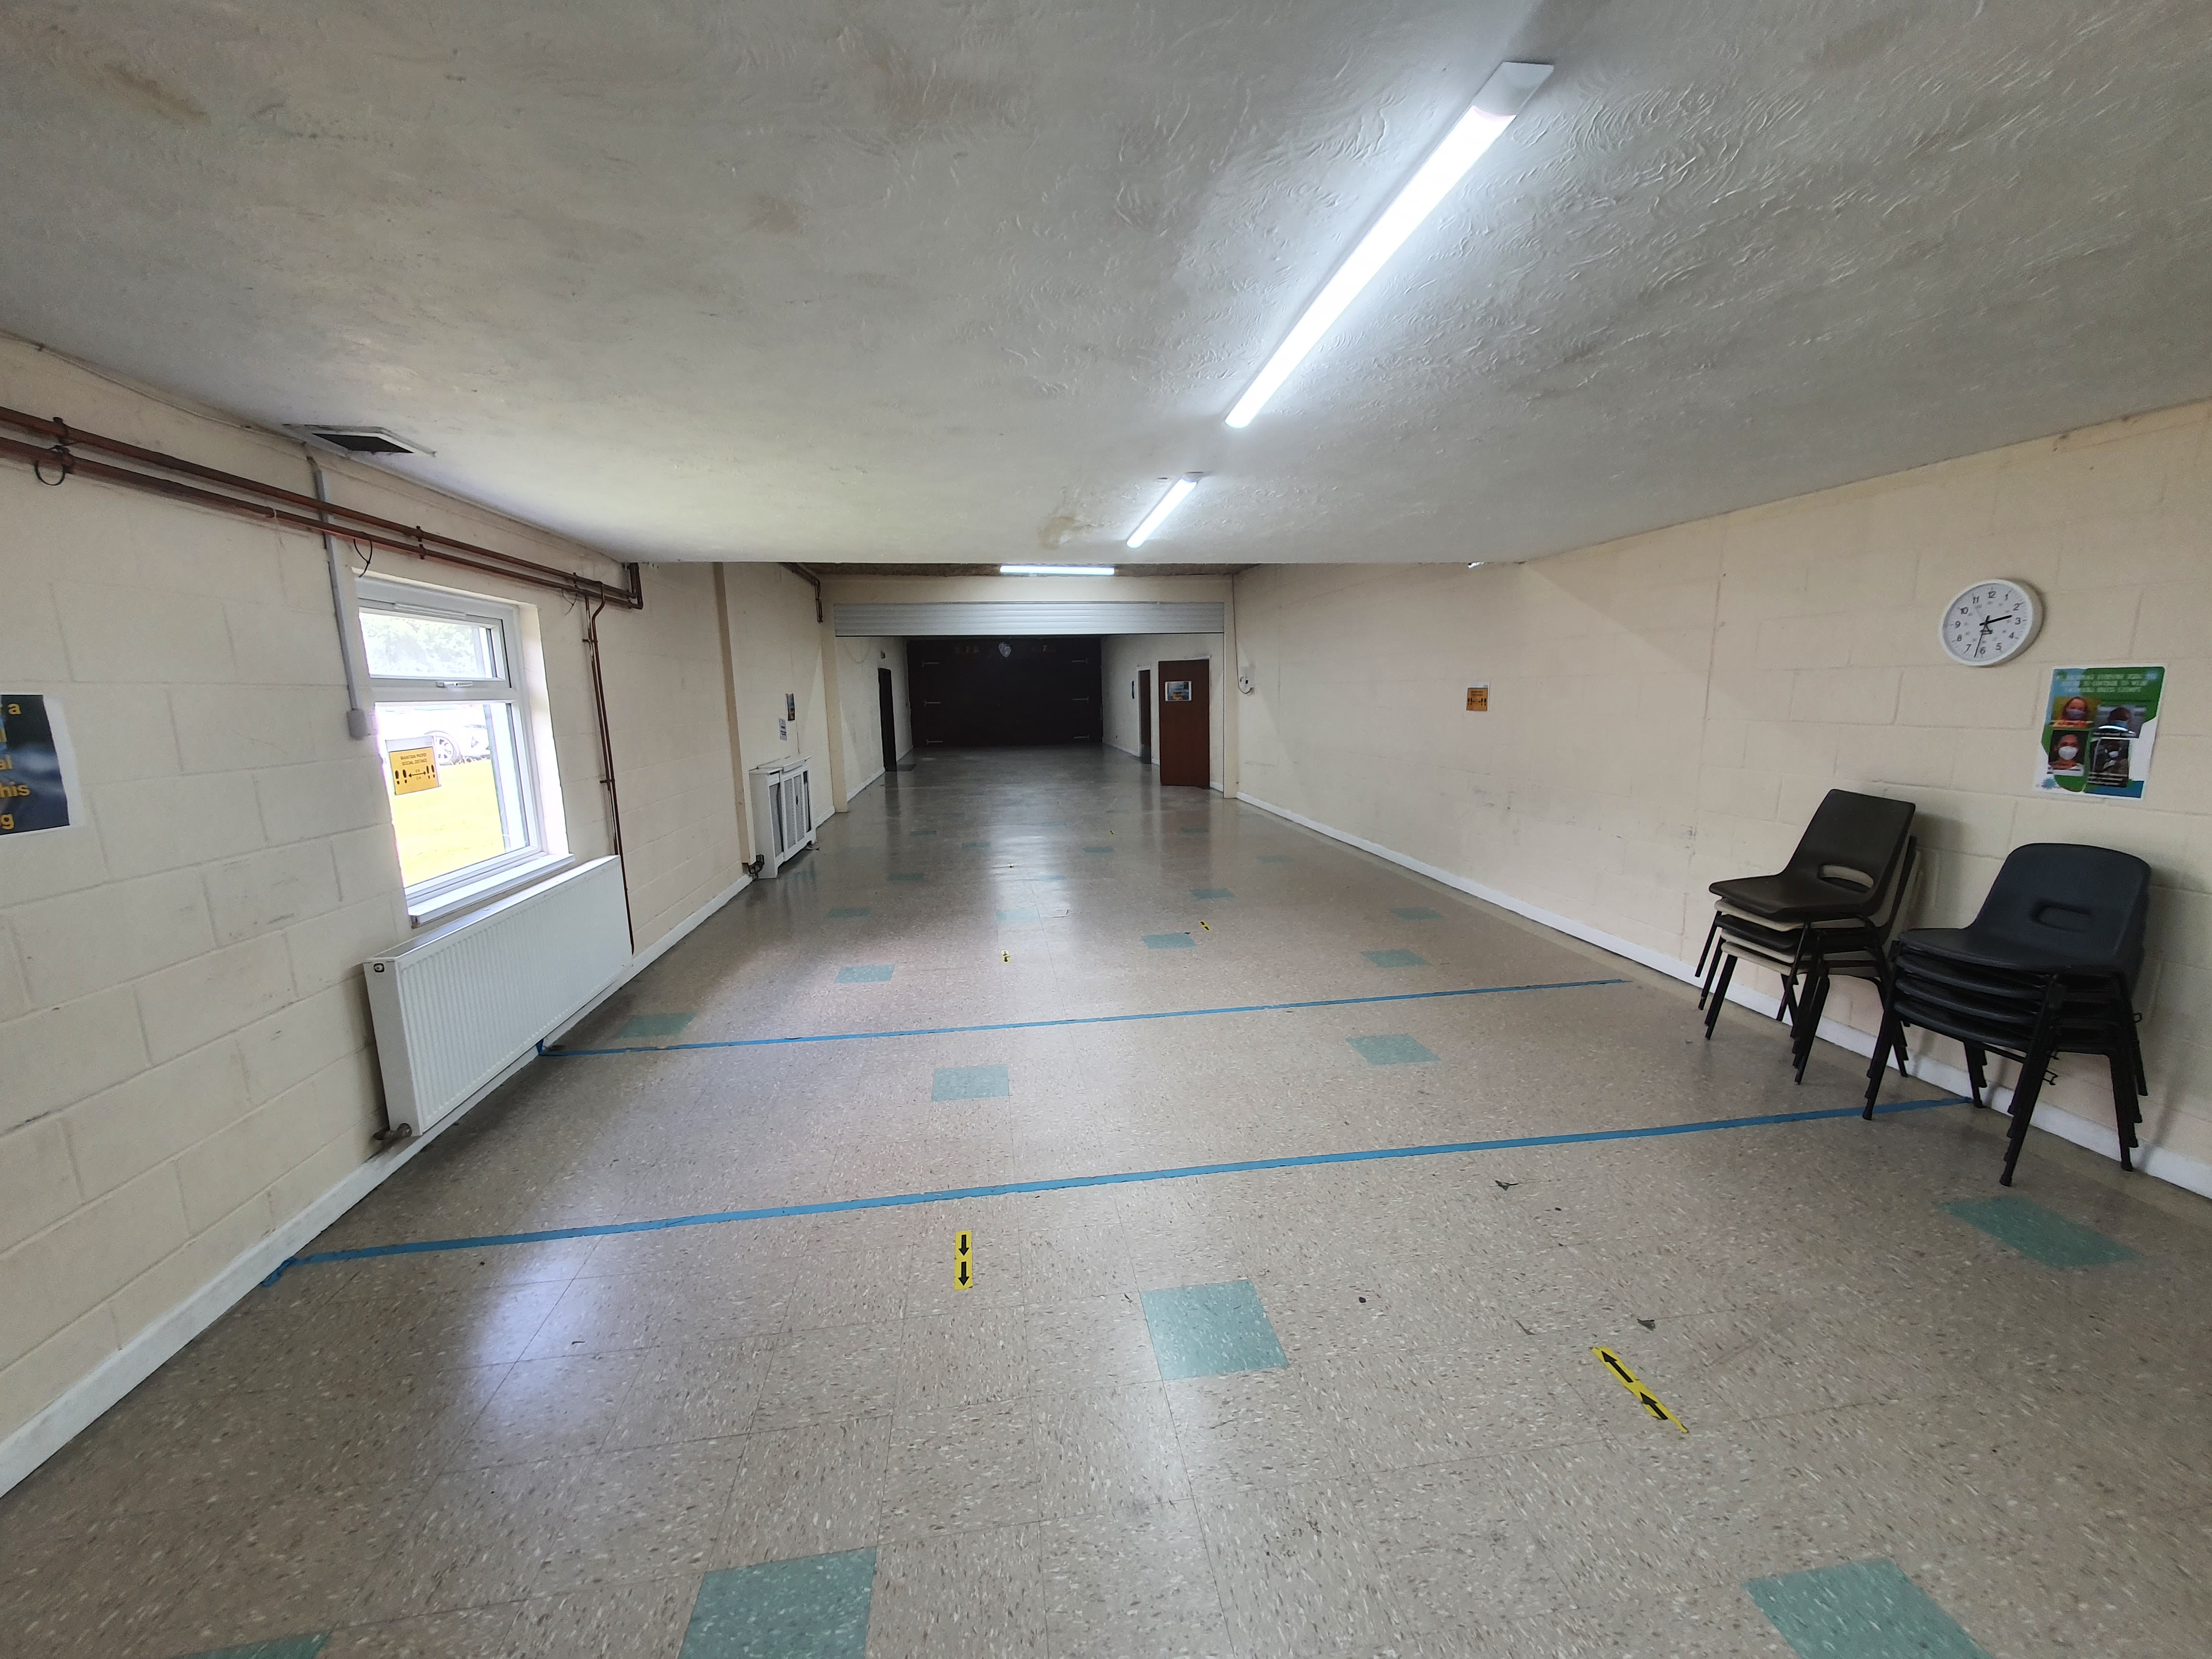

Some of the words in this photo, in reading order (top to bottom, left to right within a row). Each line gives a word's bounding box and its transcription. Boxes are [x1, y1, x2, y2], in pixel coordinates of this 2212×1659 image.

[1965, 644, 1972, 652] 7
[1996, 642, 2002, 650] 5
[8, 703, 22, 715] a
